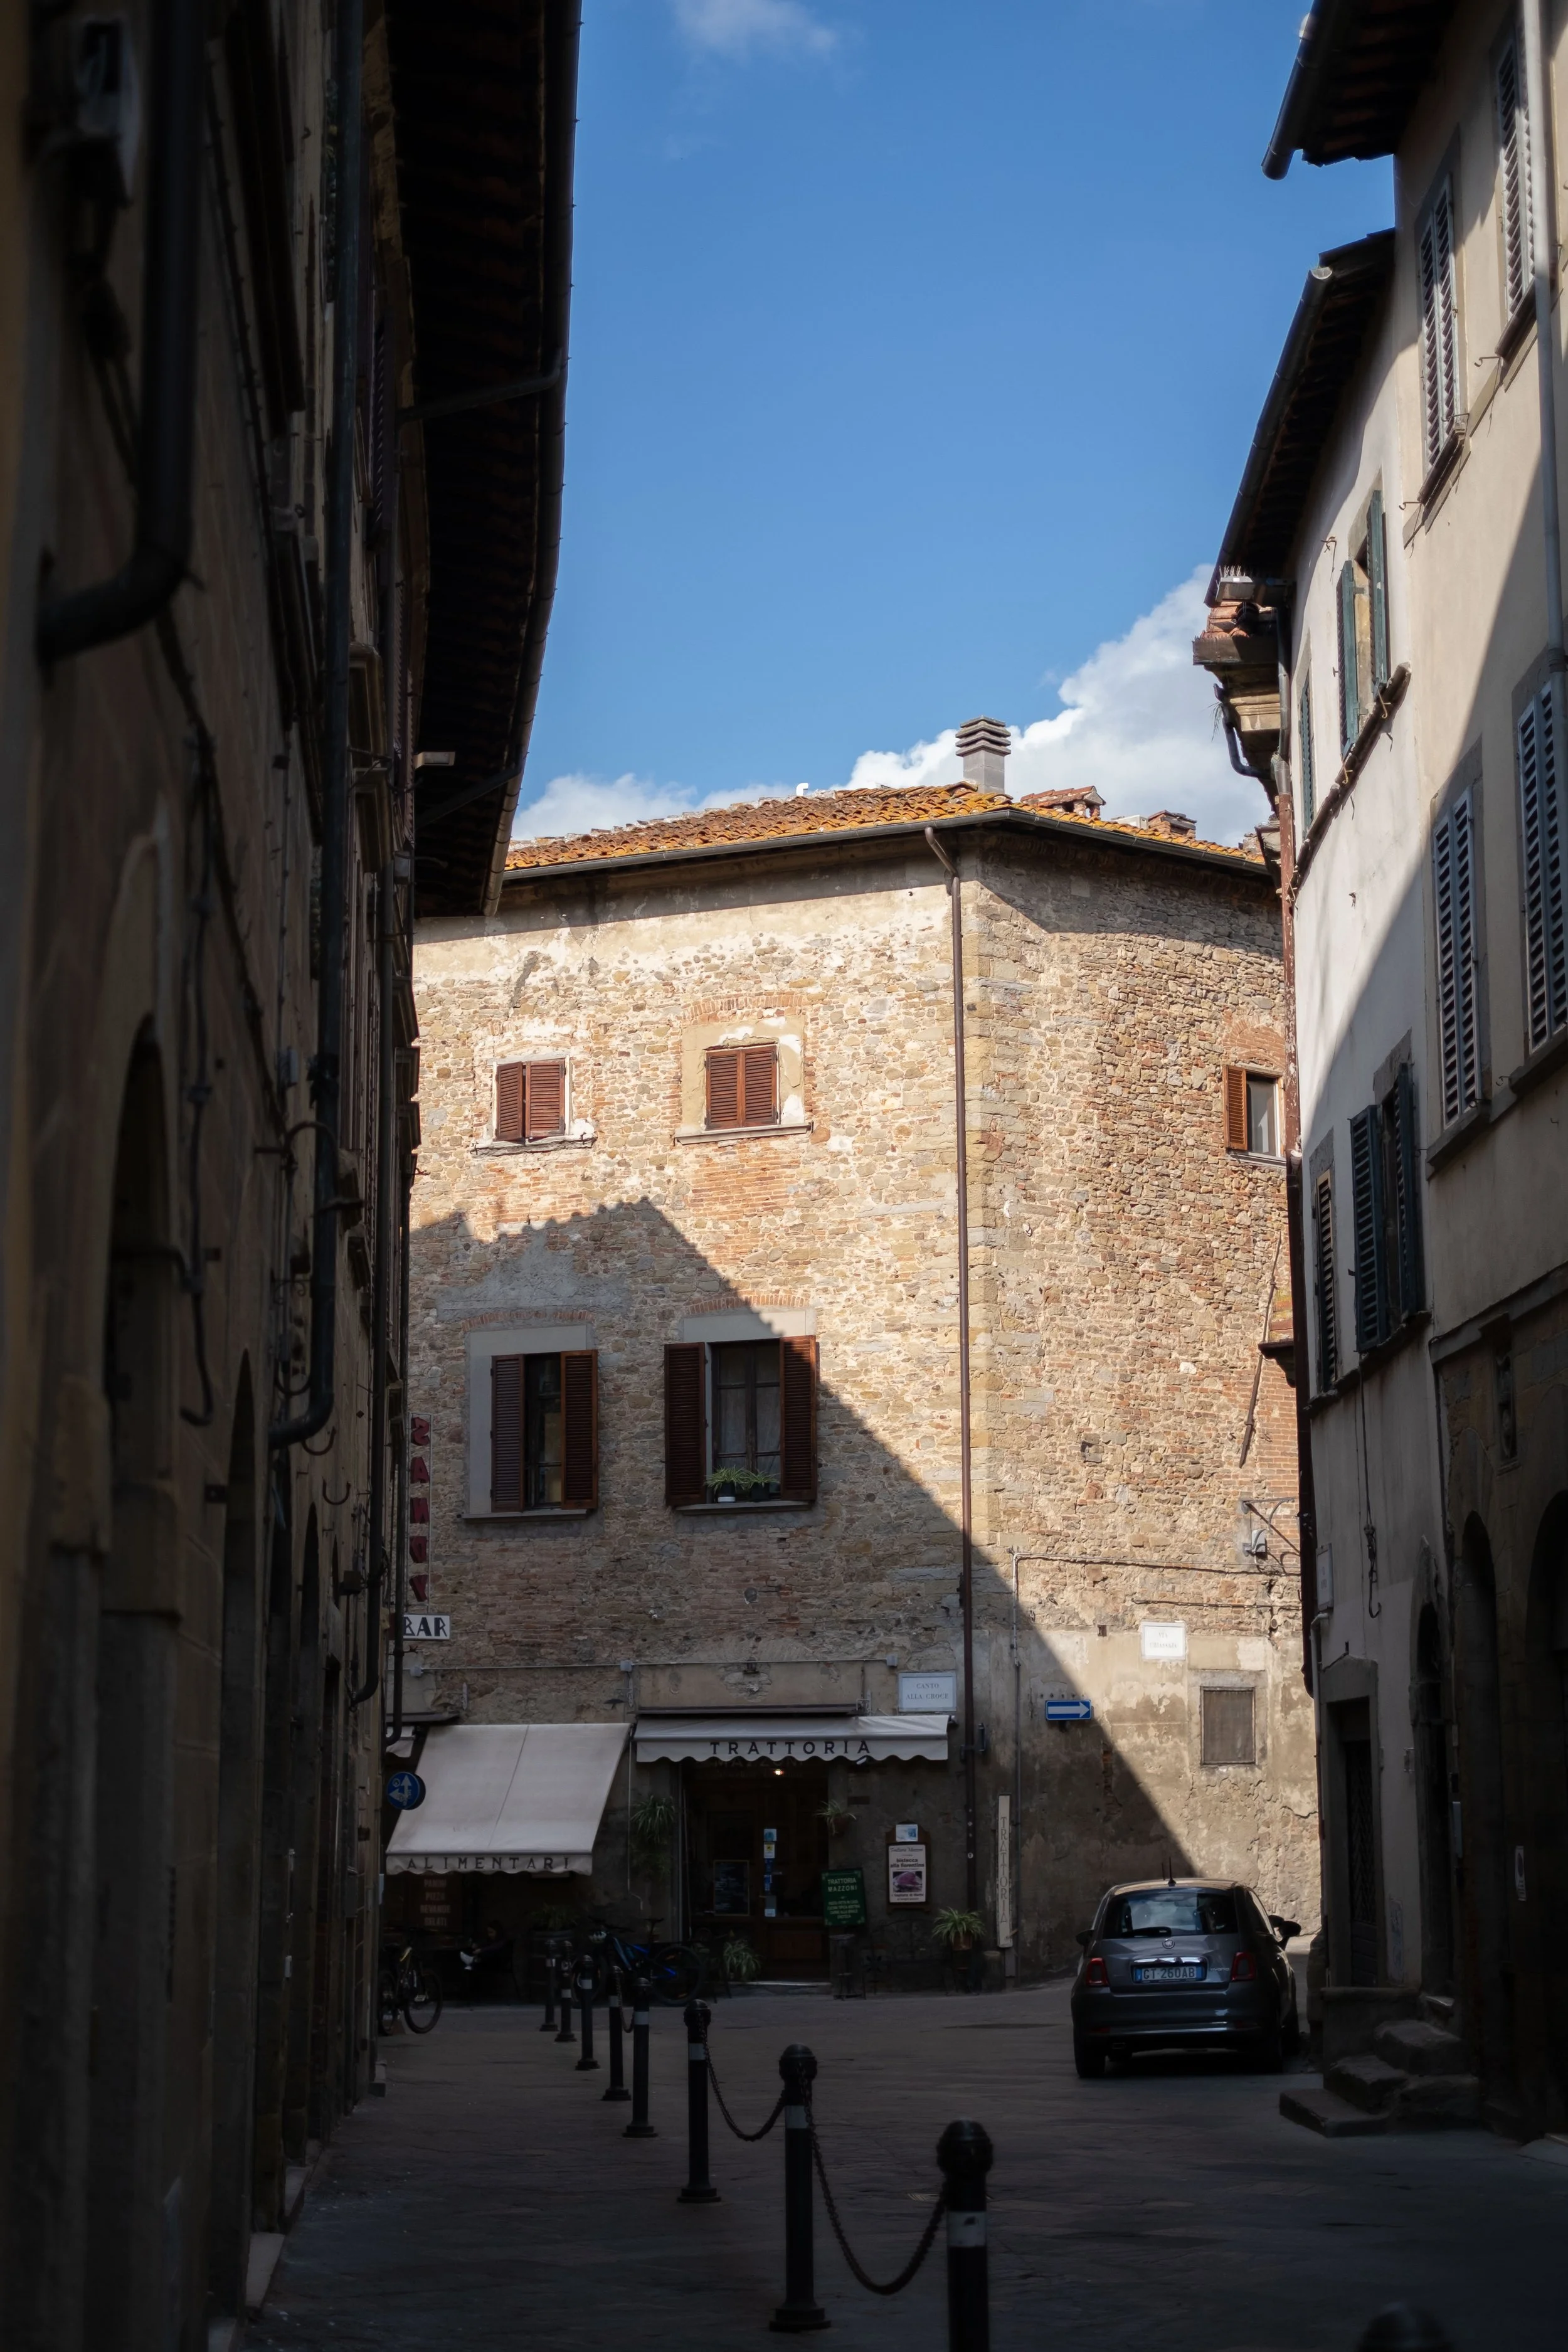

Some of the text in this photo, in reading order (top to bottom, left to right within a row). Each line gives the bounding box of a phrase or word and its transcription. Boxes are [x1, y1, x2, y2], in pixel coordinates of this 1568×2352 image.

[403, 1616, 447, 1637] BAR
[710, 1740, 870, 1754] TRATTORIA
[407, 1857, 569, 1870] ALIMENTARI
[1000, 1816, 1008, 1923] TRATTORIA
[1143, 1968, 1195, 1979] GT 260AB
